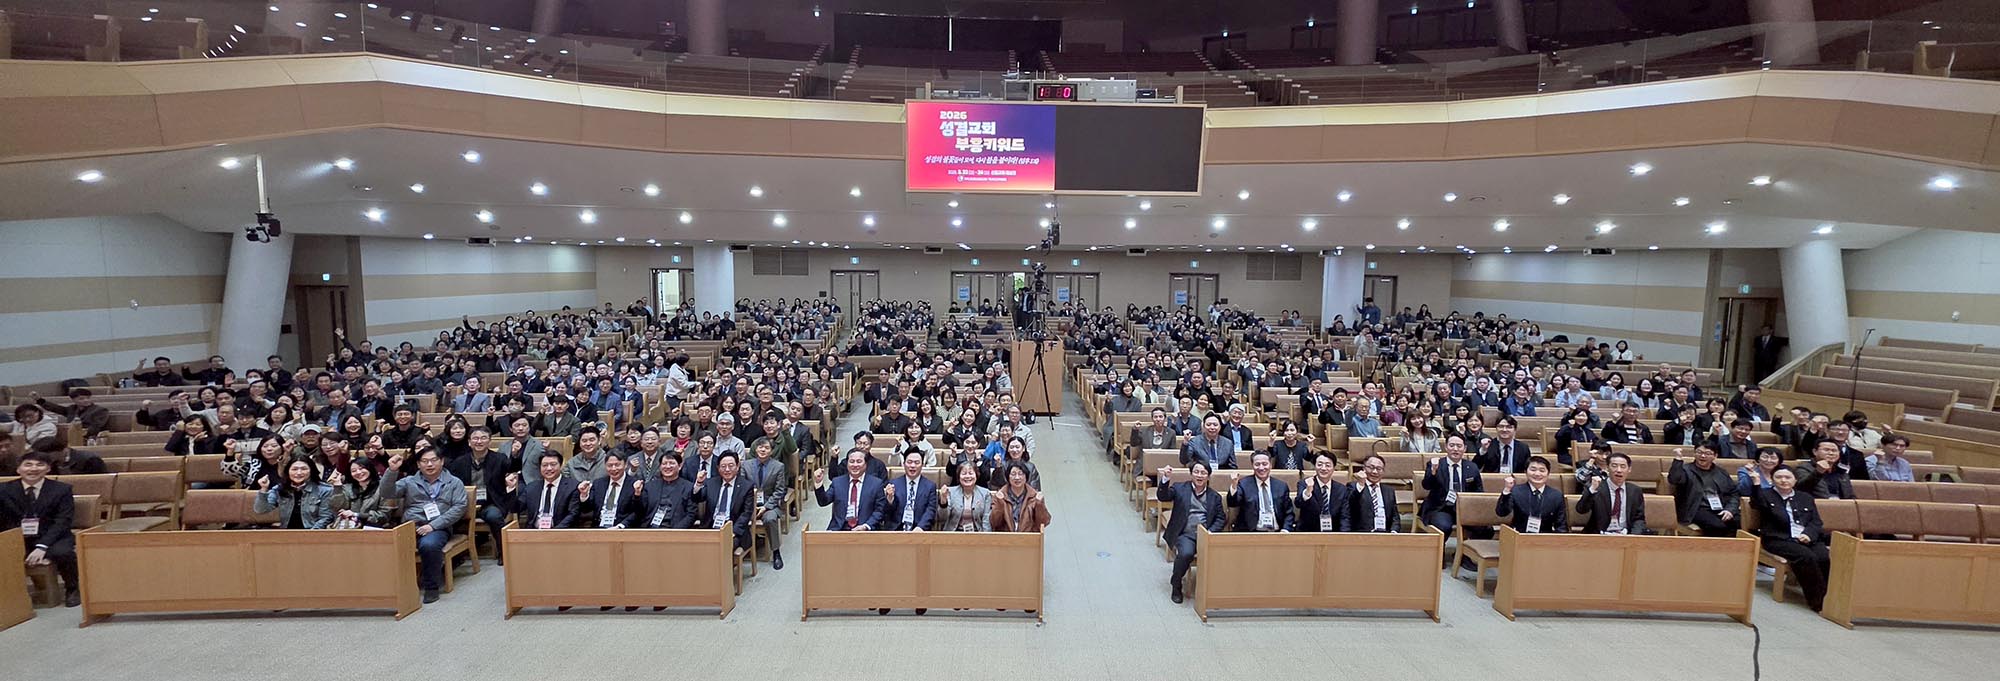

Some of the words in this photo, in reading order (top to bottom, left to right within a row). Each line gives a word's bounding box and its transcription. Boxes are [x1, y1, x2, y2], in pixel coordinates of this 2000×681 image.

[940, 111, 967, 120] 2026
[940, 121, 996, 137] 성결교회
[955, 138, 1025, 153] 부흥키워드
